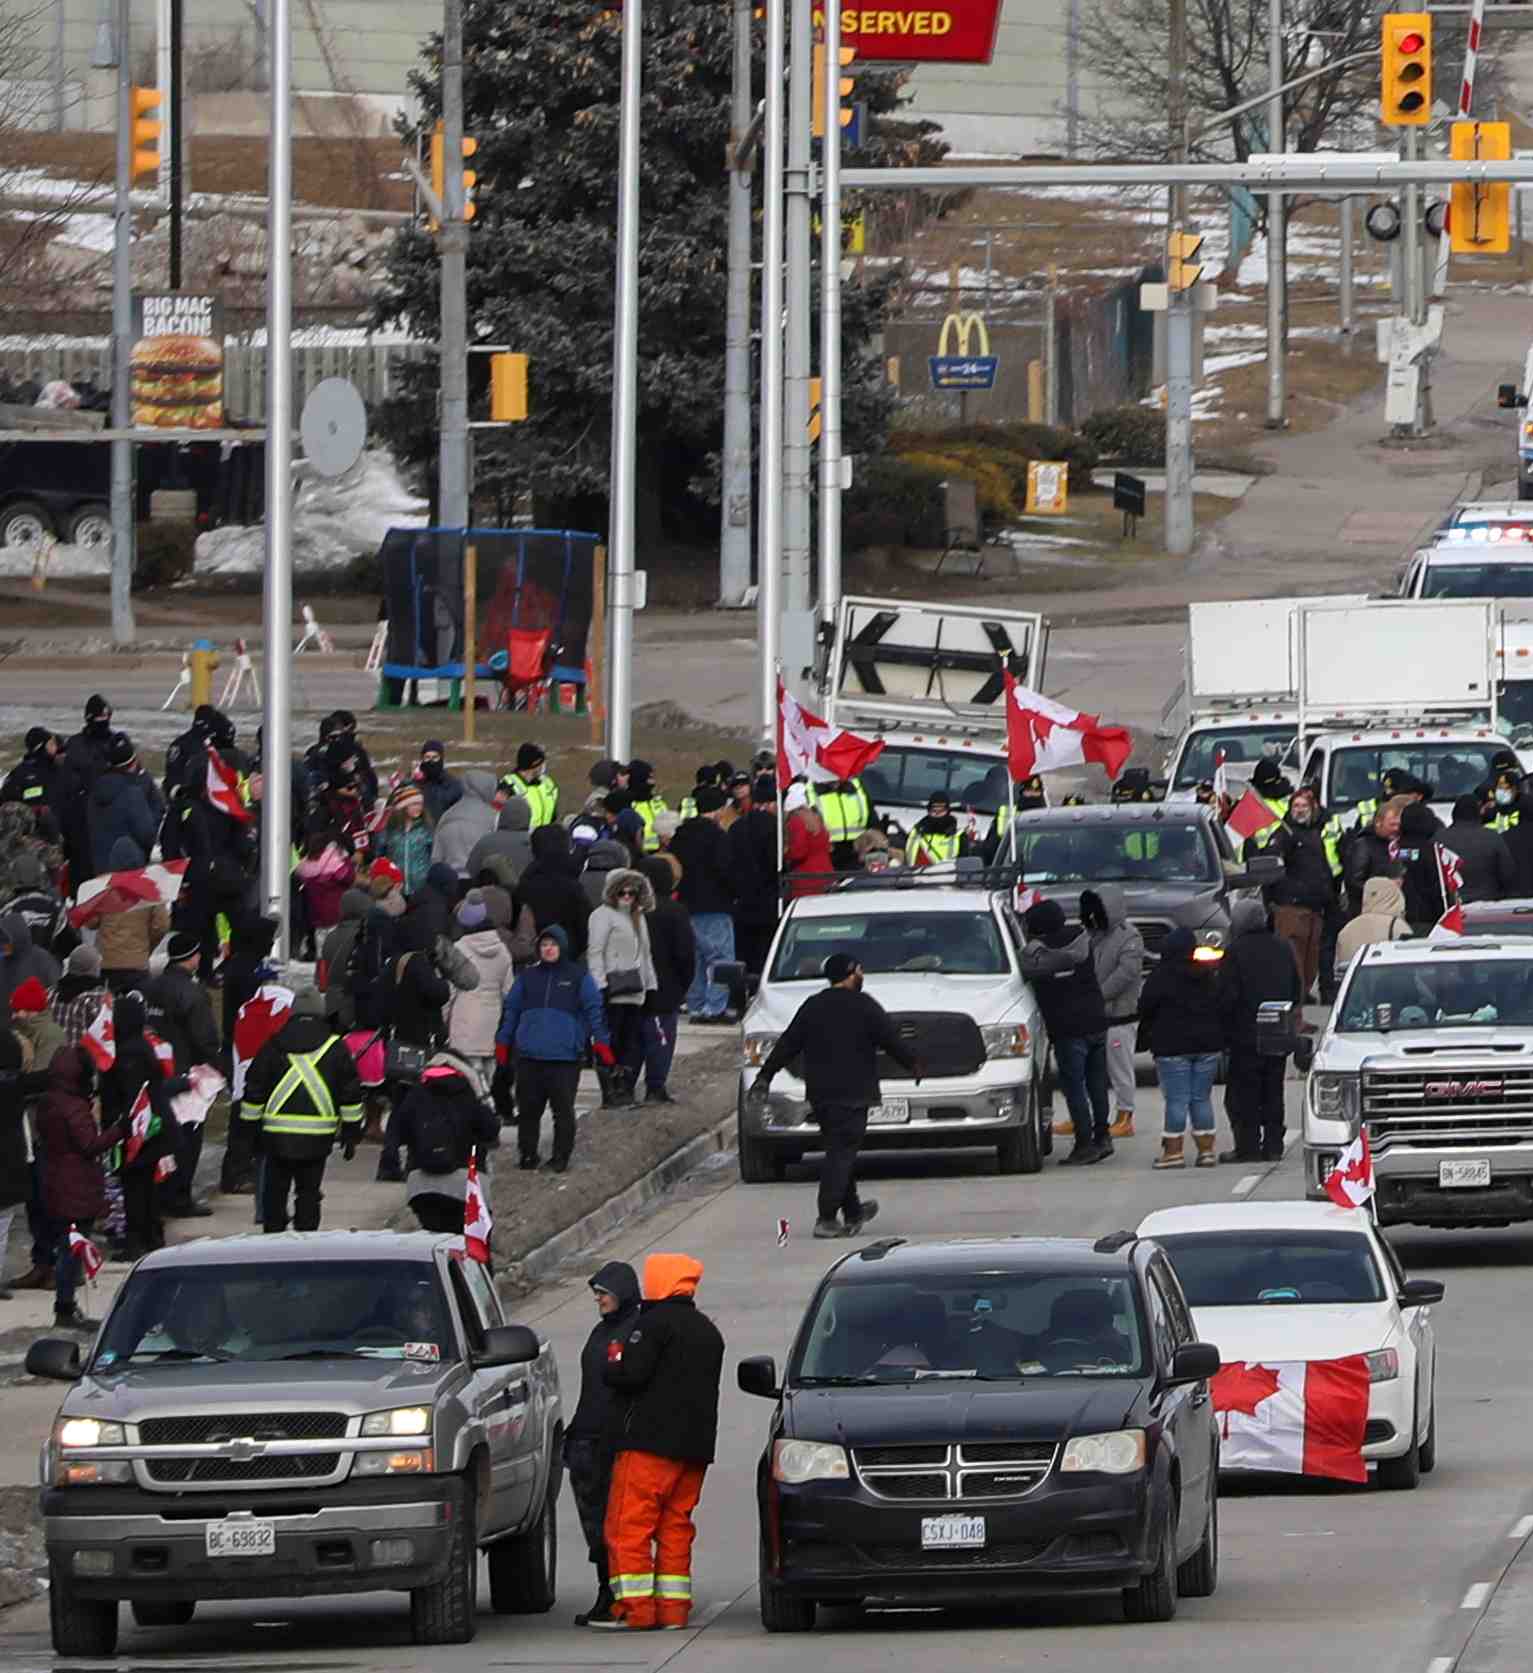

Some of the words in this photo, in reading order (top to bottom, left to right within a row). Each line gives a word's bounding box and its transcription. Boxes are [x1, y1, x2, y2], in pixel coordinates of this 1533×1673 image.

[840, 10, 951, 35] SERVED
[143, 296, 172, 315] BIG
[175, 296, 211, 314] MAC
[143, 315, 212, 337] BACON!
[1425, 1081, 1502, 1098] GMC
